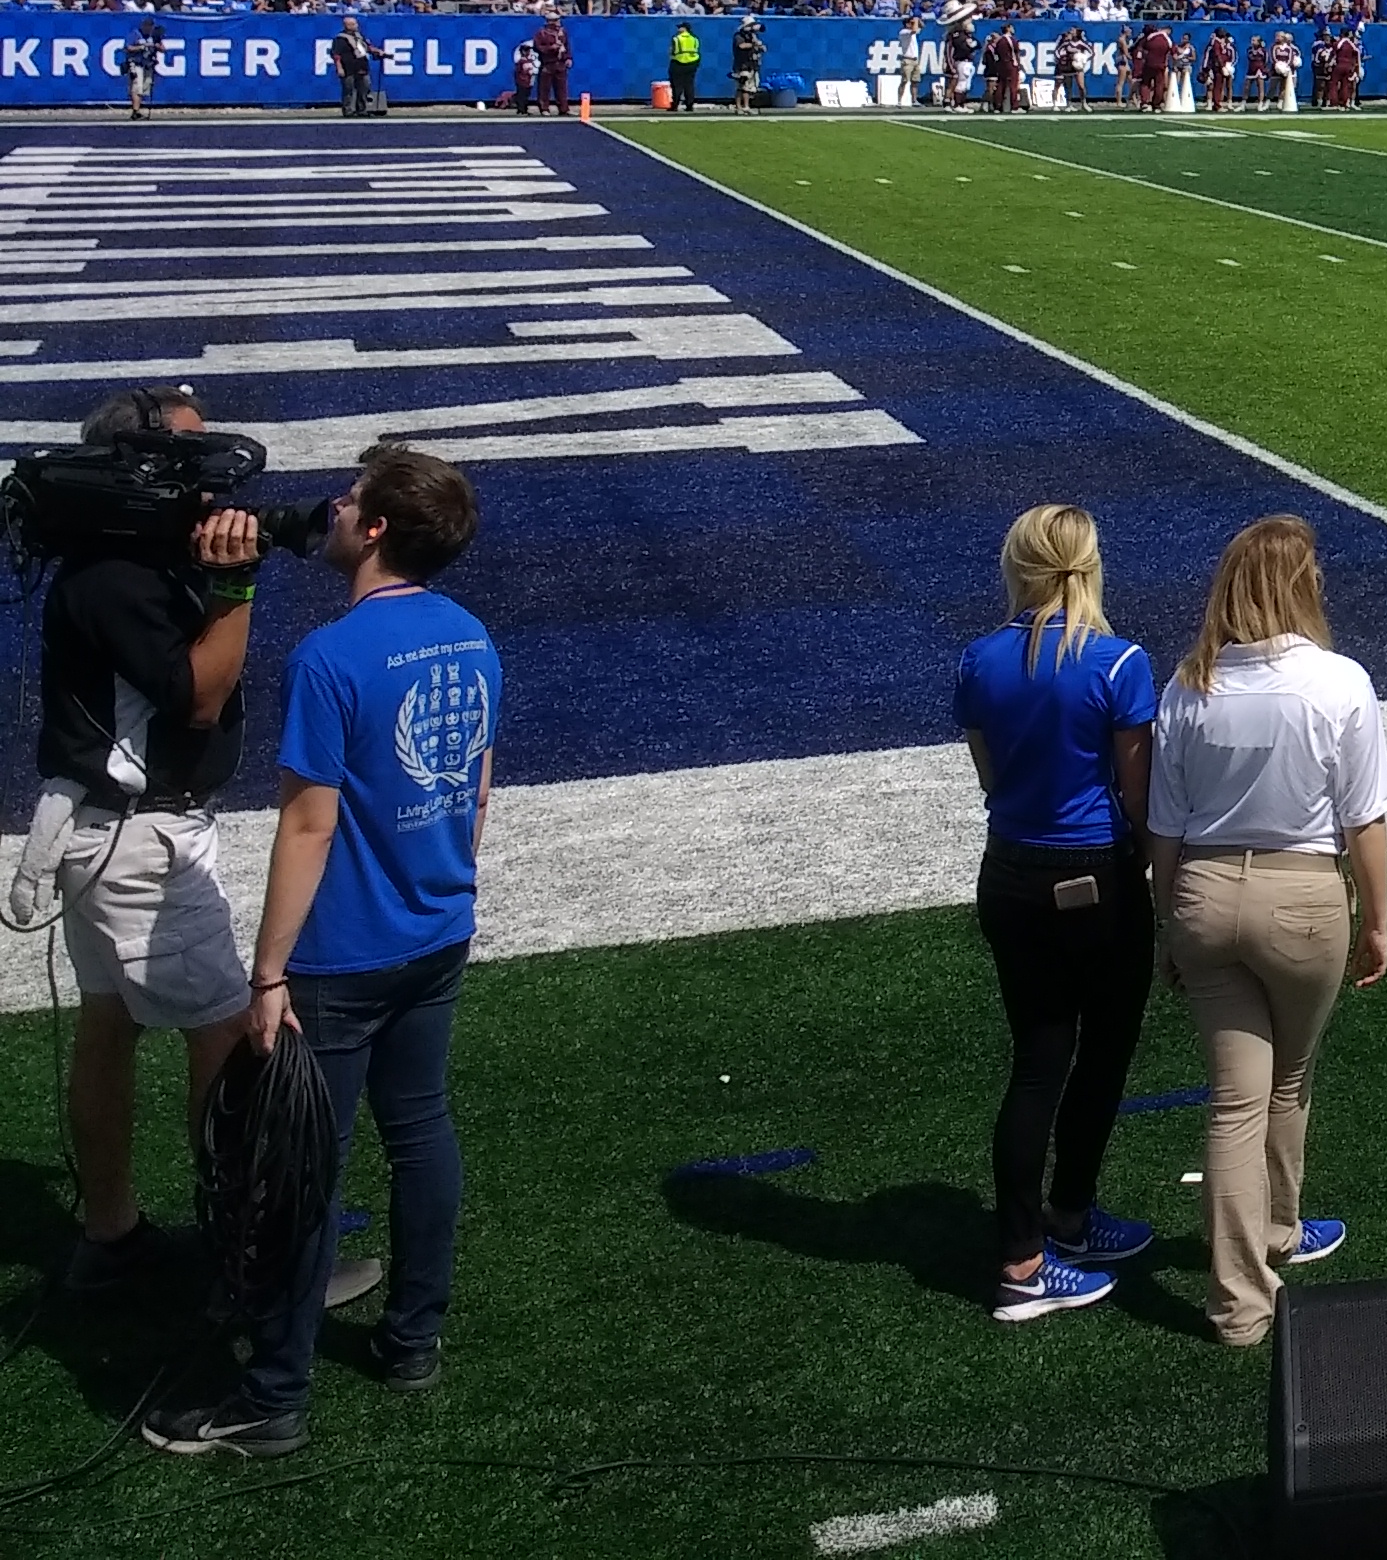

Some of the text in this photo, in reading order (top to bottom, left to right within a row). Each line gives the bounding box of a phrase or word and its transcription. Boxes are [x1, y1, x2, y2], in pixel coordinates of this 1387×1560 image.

[315, 39, 499, 76] FELD
[387, 652, 405, 670] Ask
[405, 649, 418, 663] me
[418, 643, 440, 659] about
[440, 643, 453, 657] my
